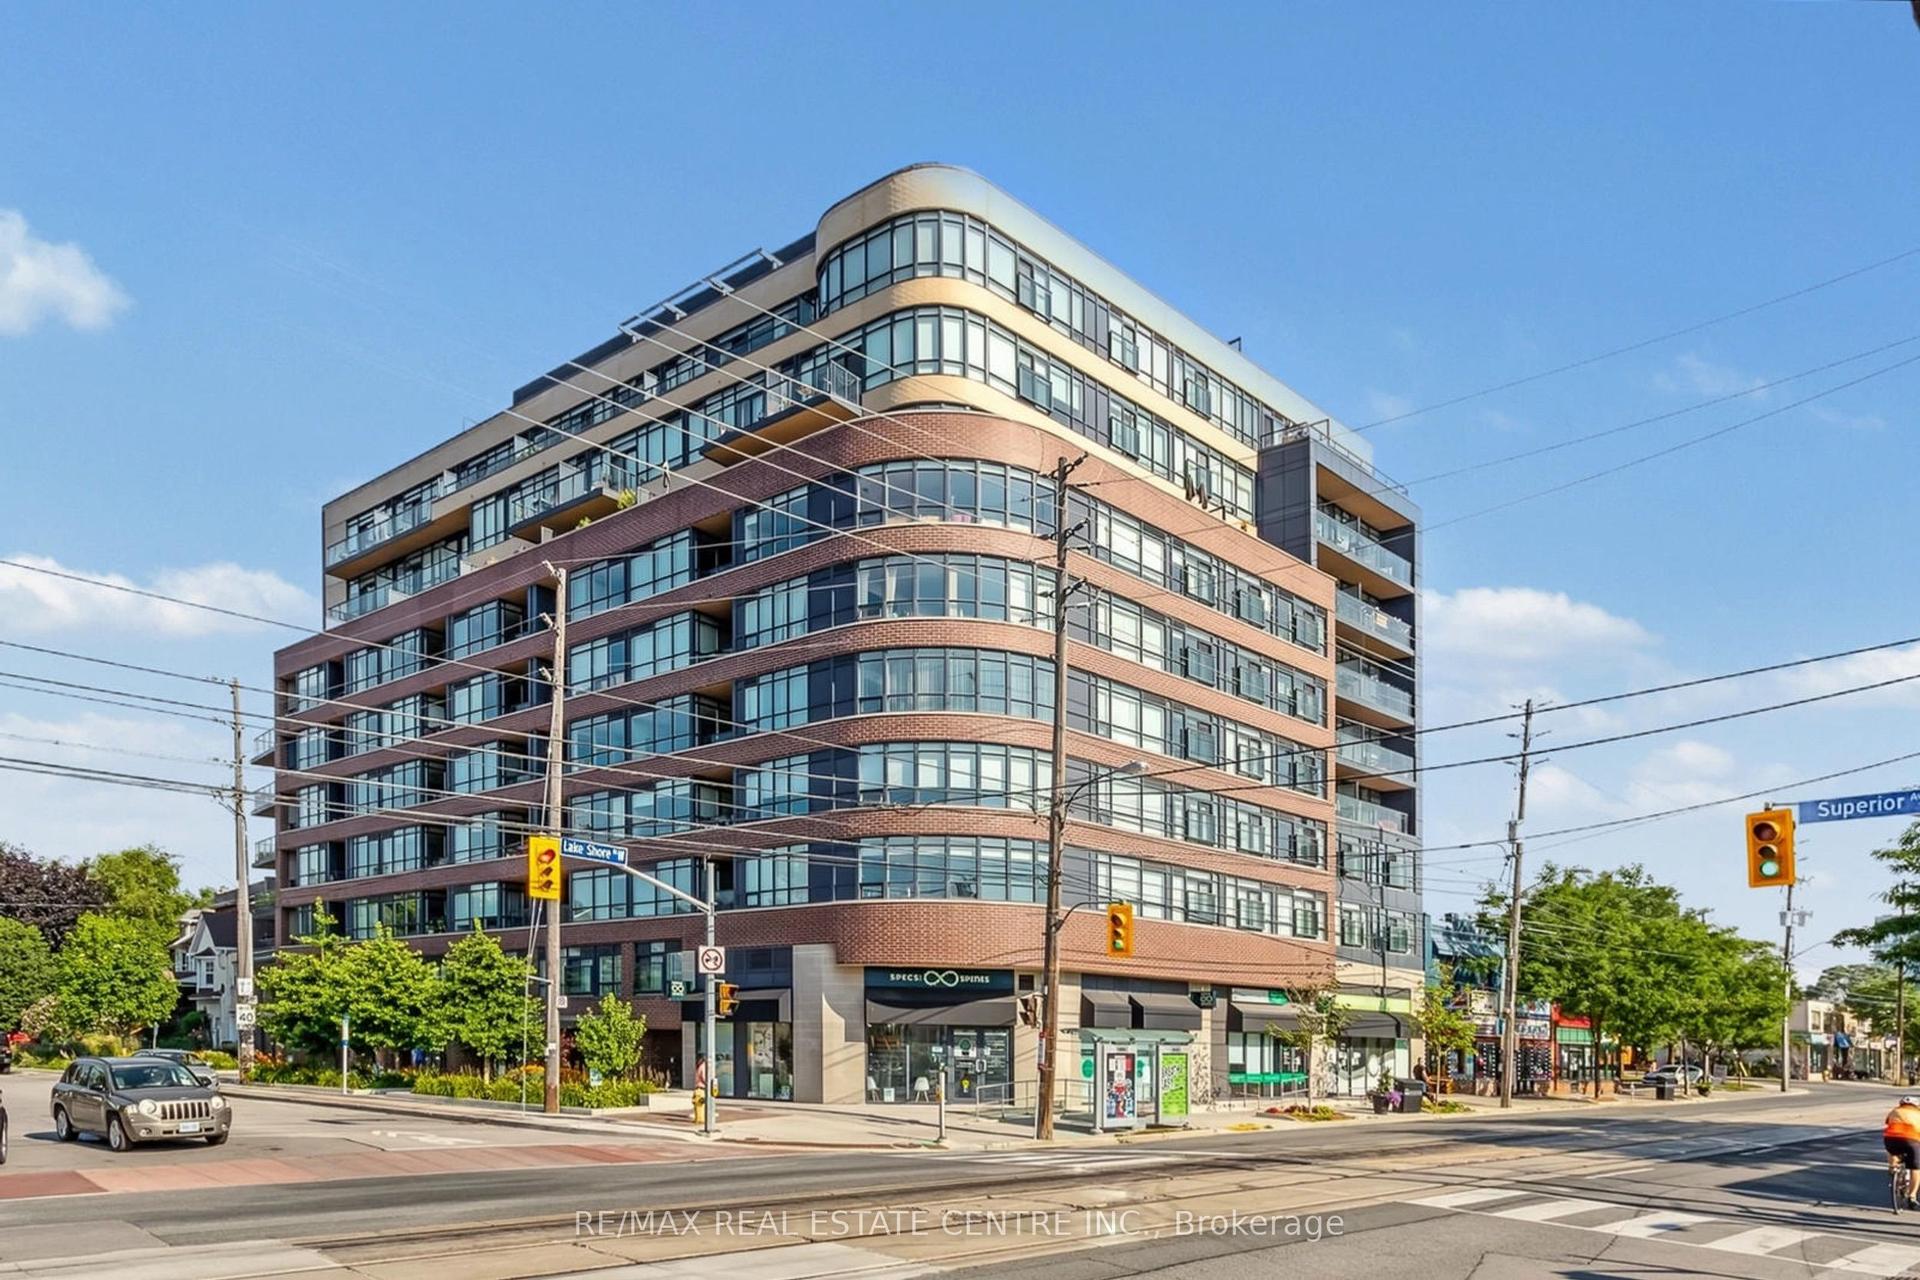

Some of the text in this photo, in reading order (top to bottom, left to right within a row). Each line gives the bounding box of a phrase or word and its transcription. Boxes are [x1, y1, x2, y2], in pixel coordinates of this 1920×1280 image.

[1817, 795, 1905, 818] Superior
[563, 839, 584, 855] Lake
[586, 844, 611, 861] Shore
[889, 973, 919, 982] SPECS
[239, 1012, 253, 1022] 40
